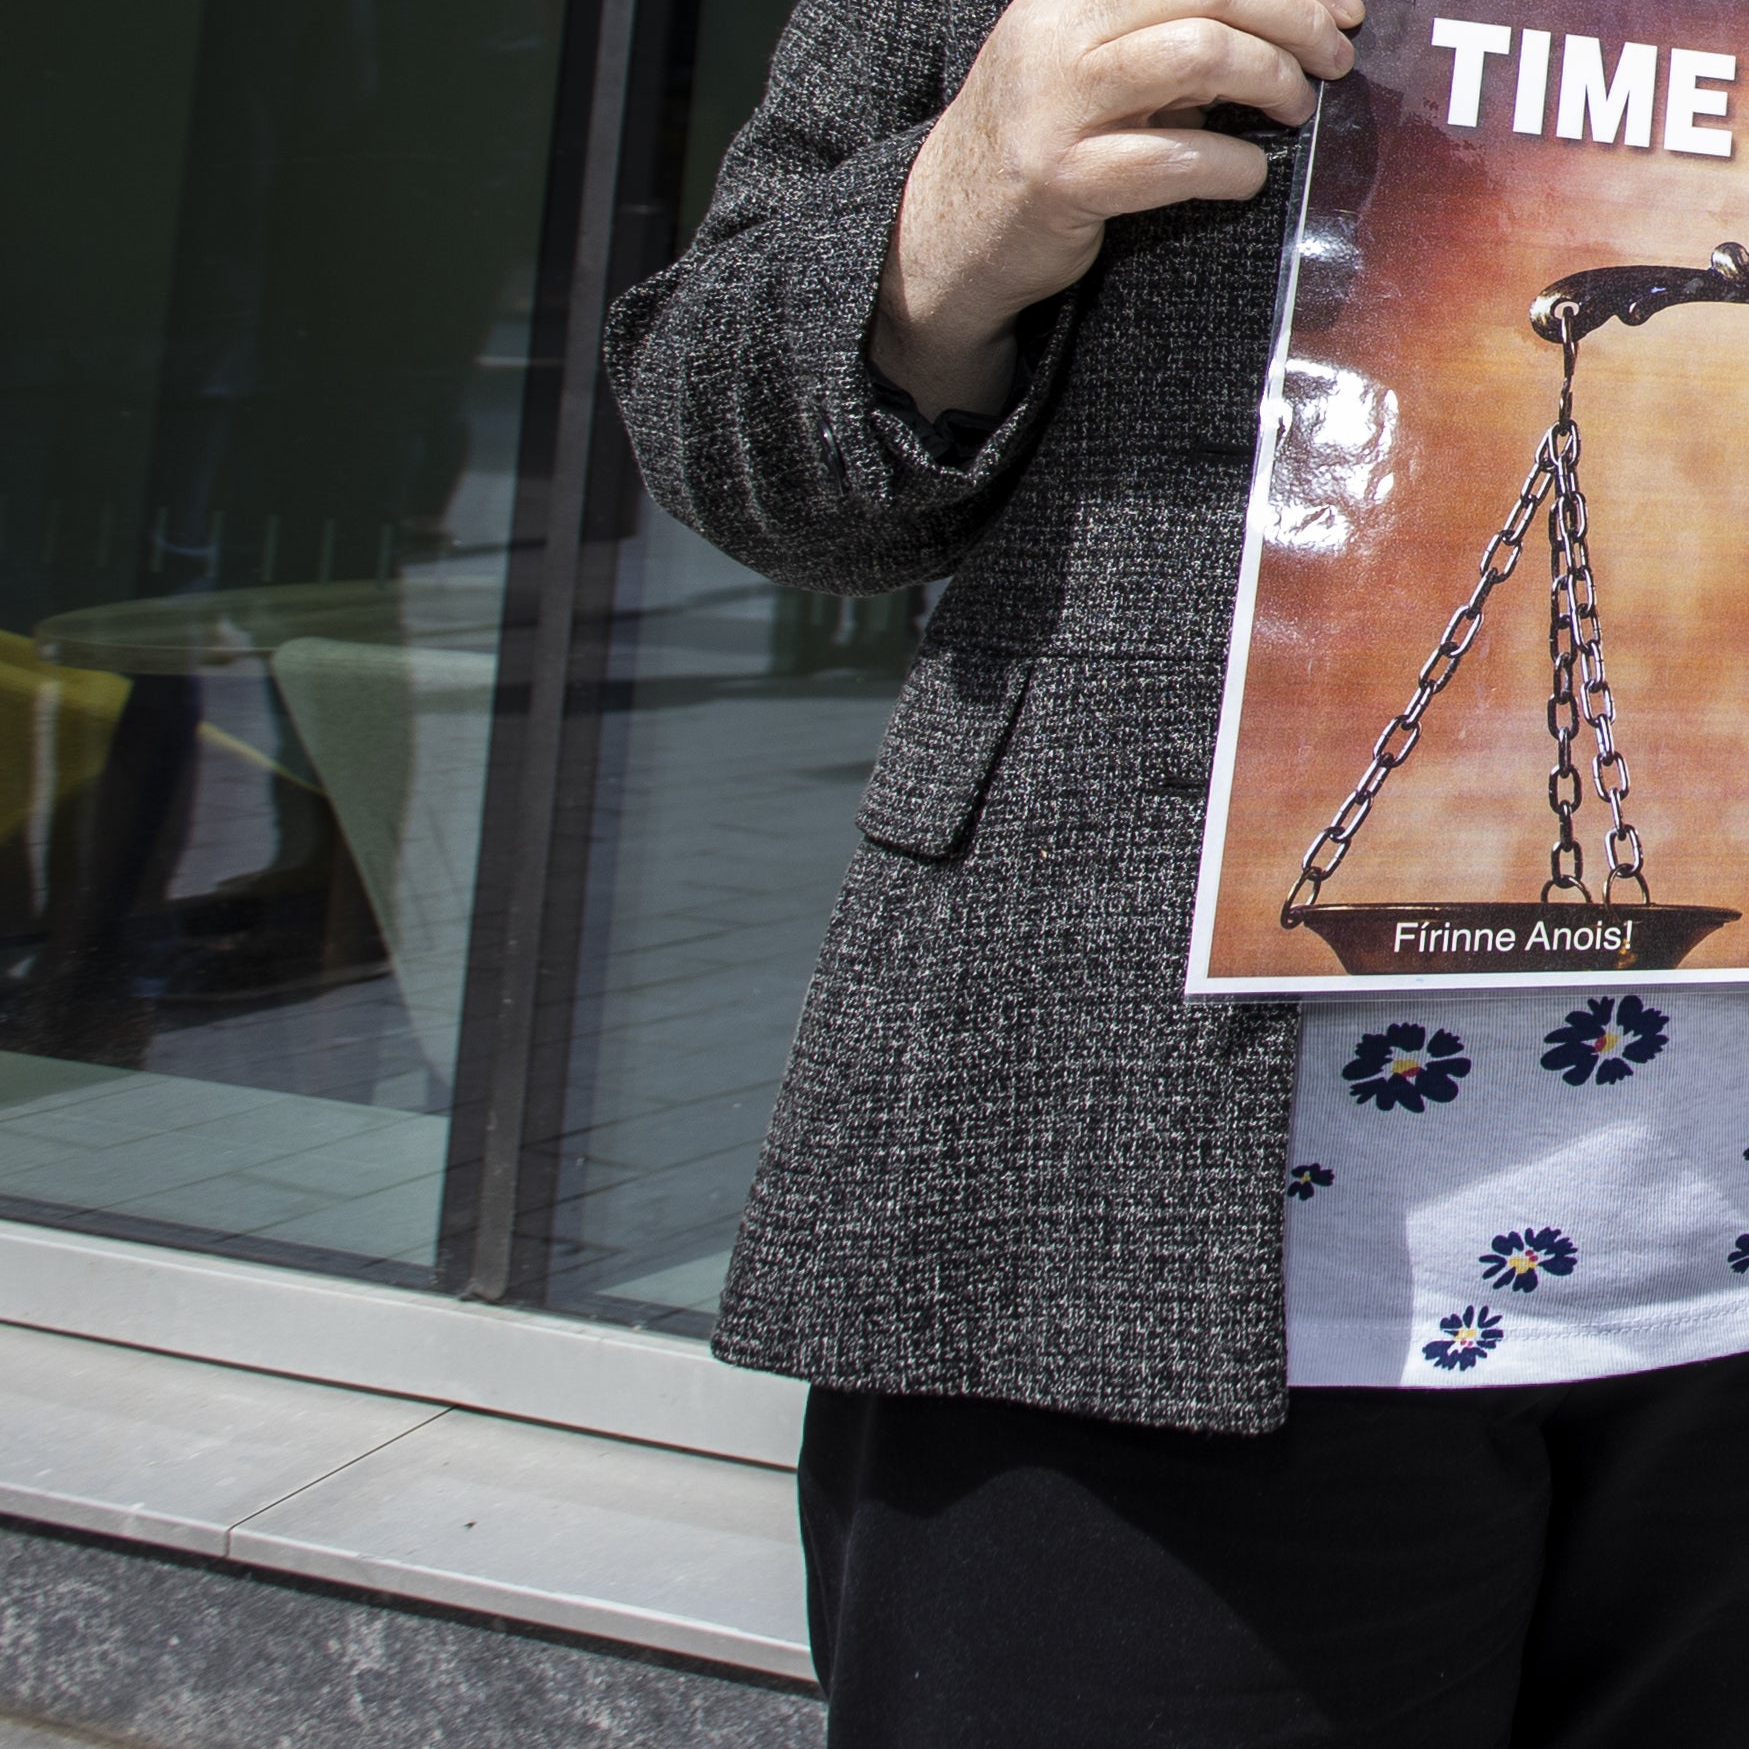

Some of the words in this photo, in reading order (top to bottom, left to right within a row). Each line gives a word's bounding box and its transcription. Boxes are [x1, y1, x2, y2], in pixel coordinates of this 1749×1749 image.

[1431, 17, 1735, 158] TIME
[1393, 920, 1517, 953] Fírinne
[1524, 919, 1634, 952] Anois!
